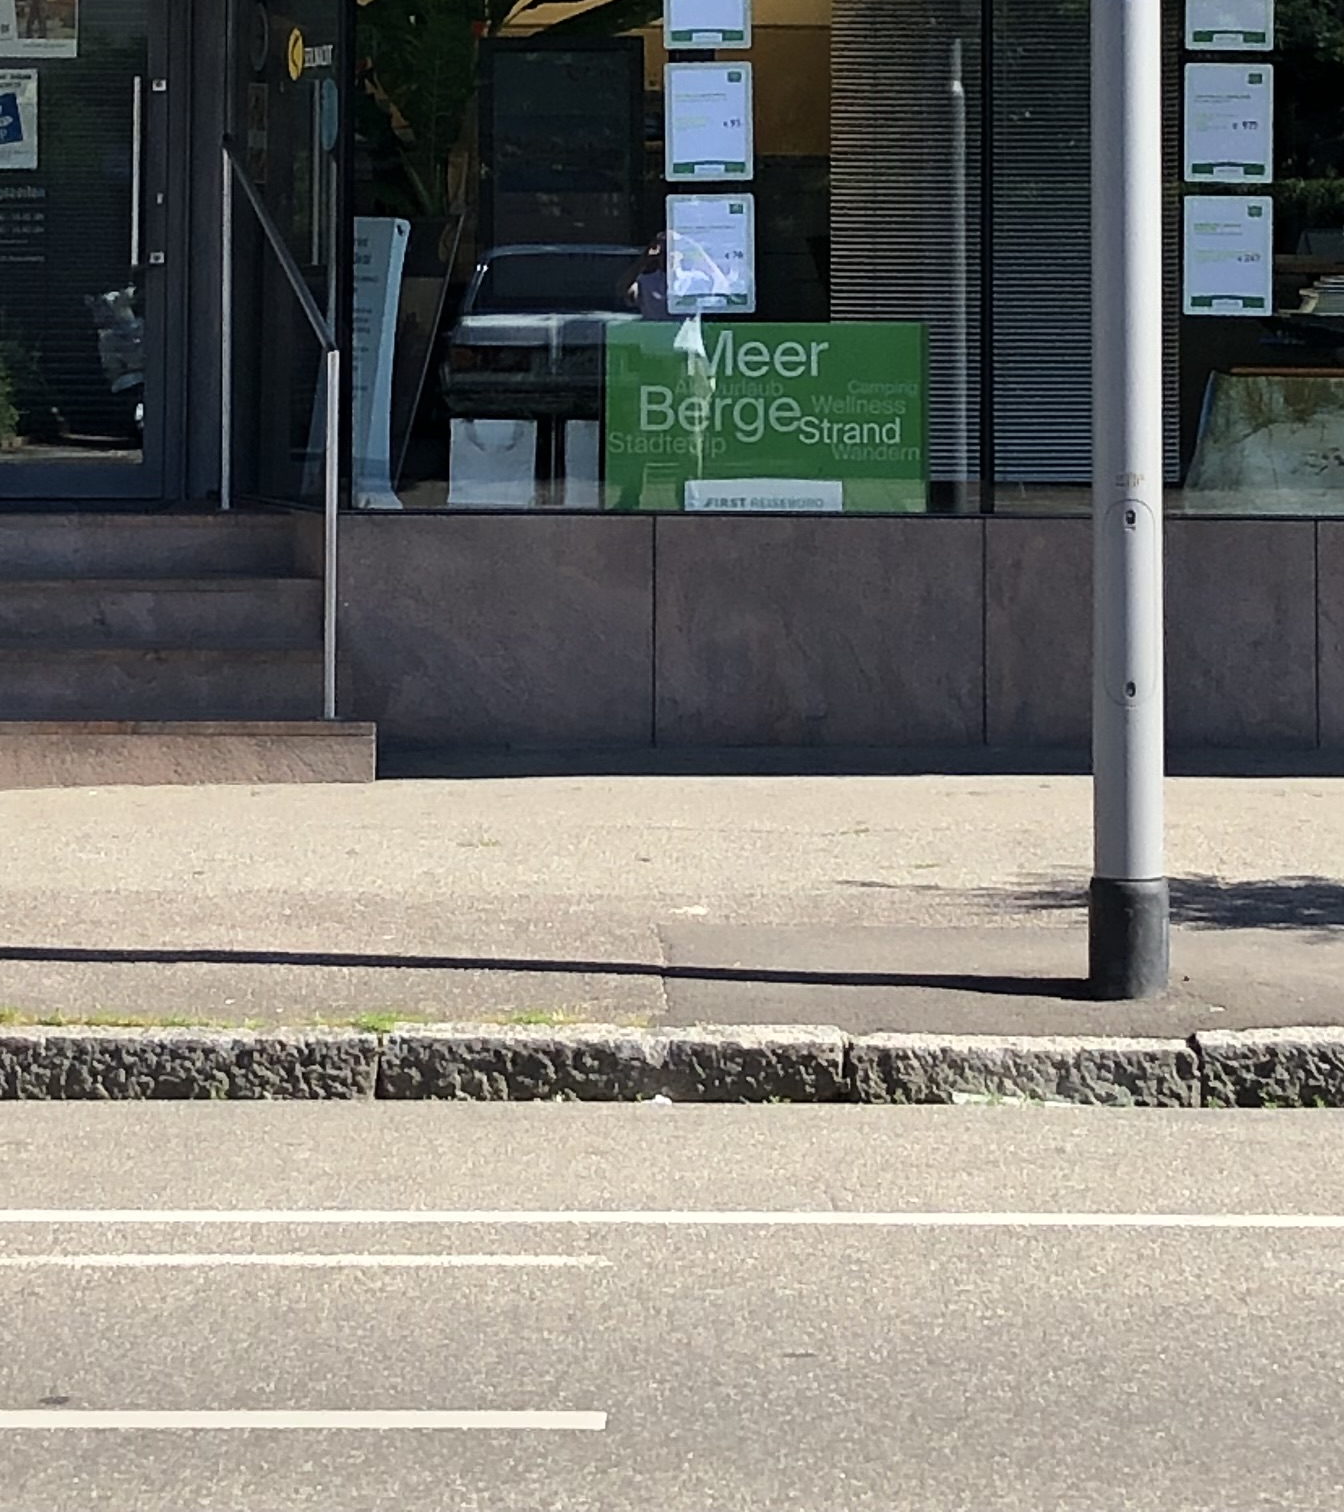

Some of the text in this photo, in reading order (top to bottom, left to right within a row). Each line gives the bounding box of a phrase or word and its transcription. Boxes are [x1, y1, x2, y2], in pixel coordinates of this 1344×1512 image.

[640, 385, 802, 443] Berge
[811, 394, 906, 415] Wellness
[799, 416, 902, 444] Strand
[831, 444, 921, 462] Wandern
